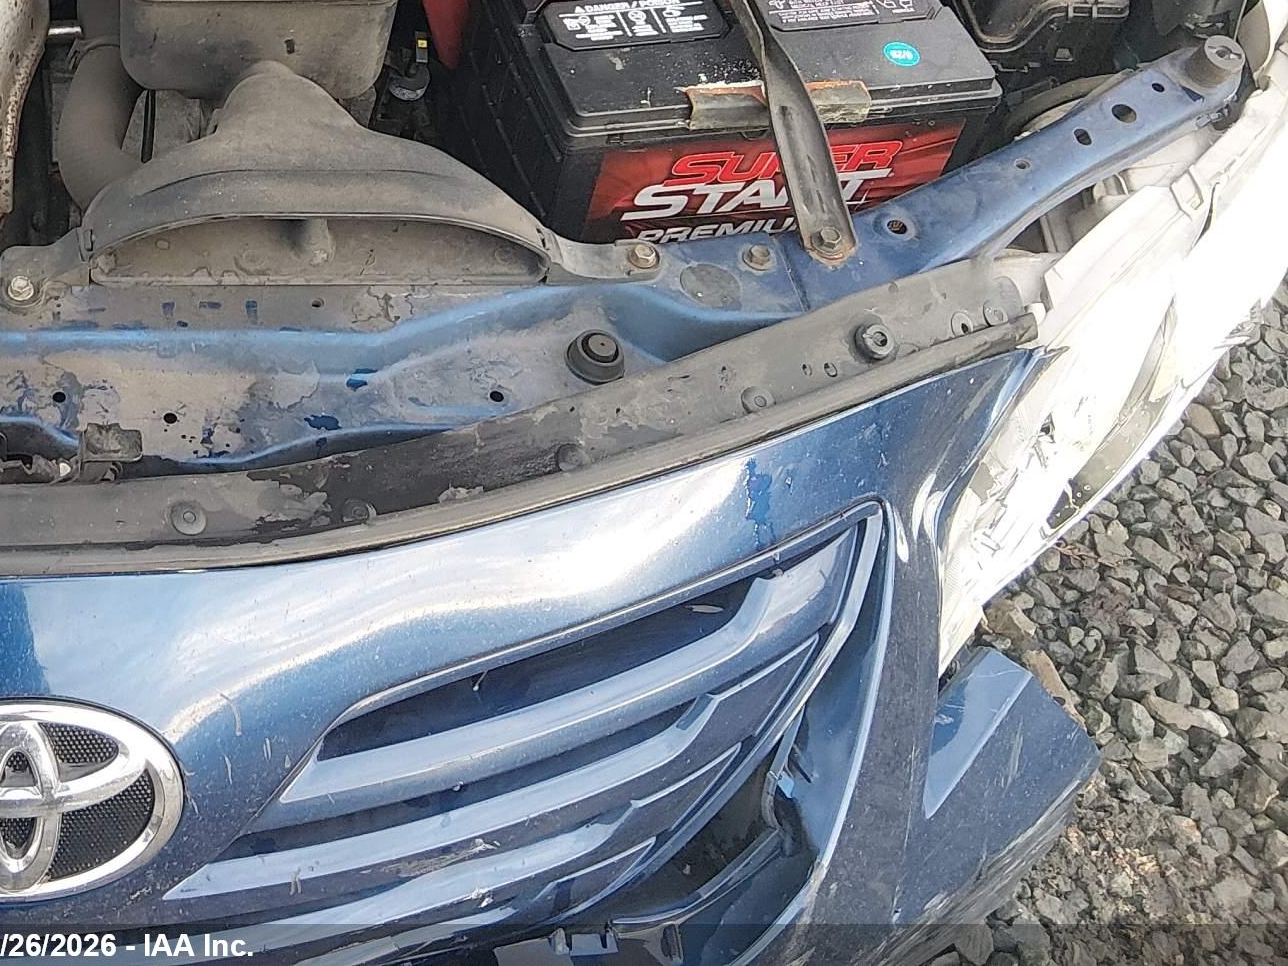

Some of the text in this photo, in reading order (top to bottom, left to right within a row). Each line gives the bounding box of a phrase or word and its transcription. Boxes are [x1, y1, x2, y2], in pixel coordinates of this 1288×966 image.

[664, 140, 903, 187] SUER
[620, 168, 893, 221] STAT
[636, 217, 798, 244] PREMIU
